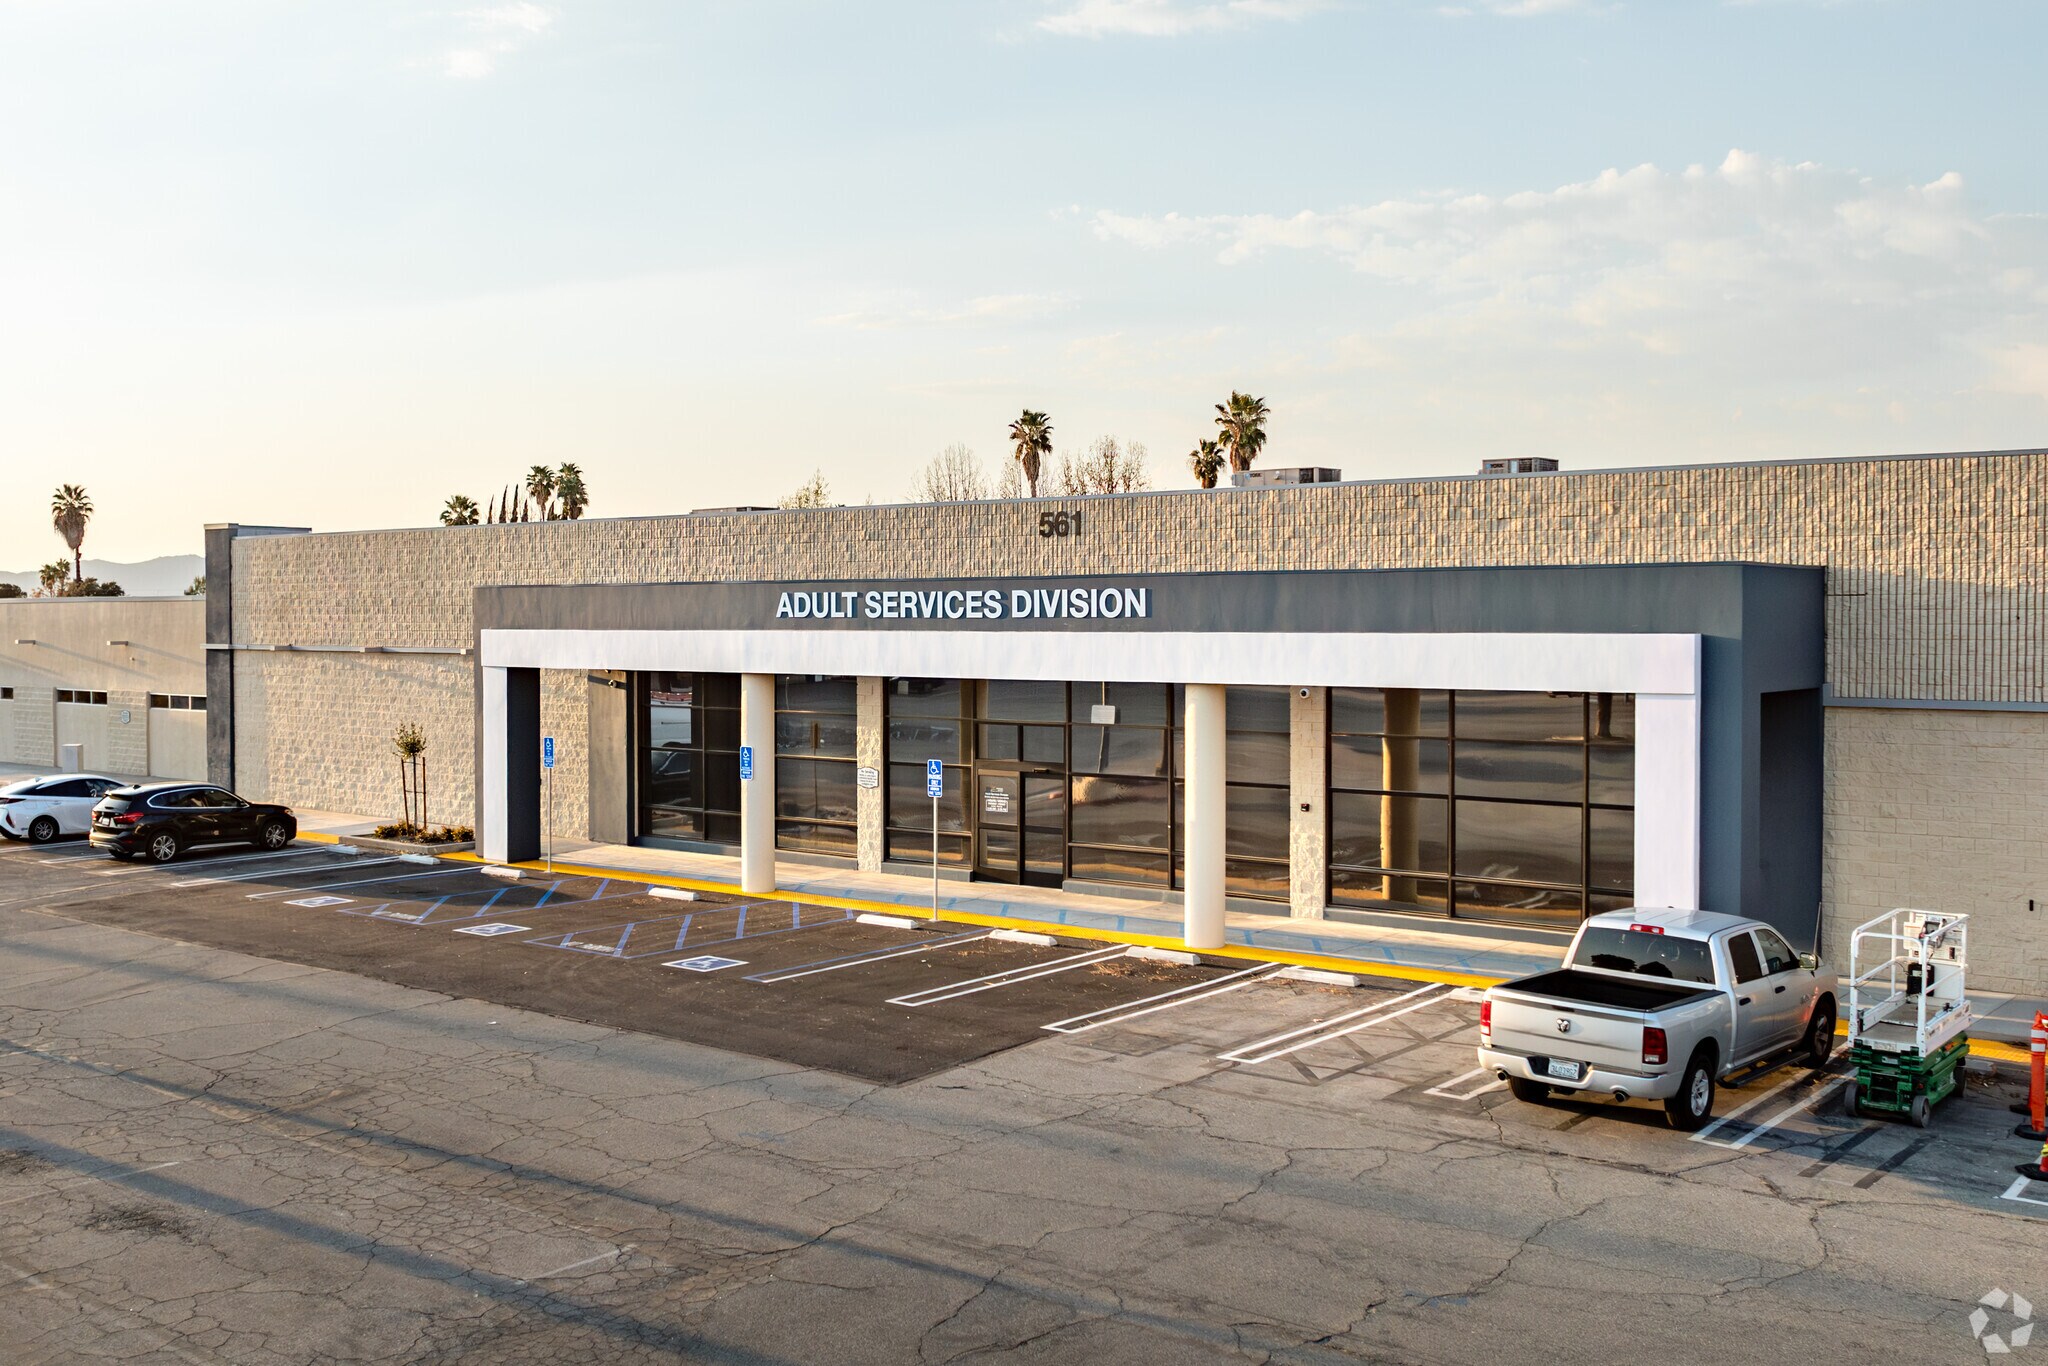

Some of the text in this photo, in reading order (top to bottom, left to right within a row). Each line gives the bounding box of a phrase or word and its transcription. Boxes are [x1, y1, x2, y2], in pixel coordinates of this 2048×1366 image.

[1039, 510, 1081, 538] 561
[776, 587, 1147, 619] ADULT SERVICES DIVISION
